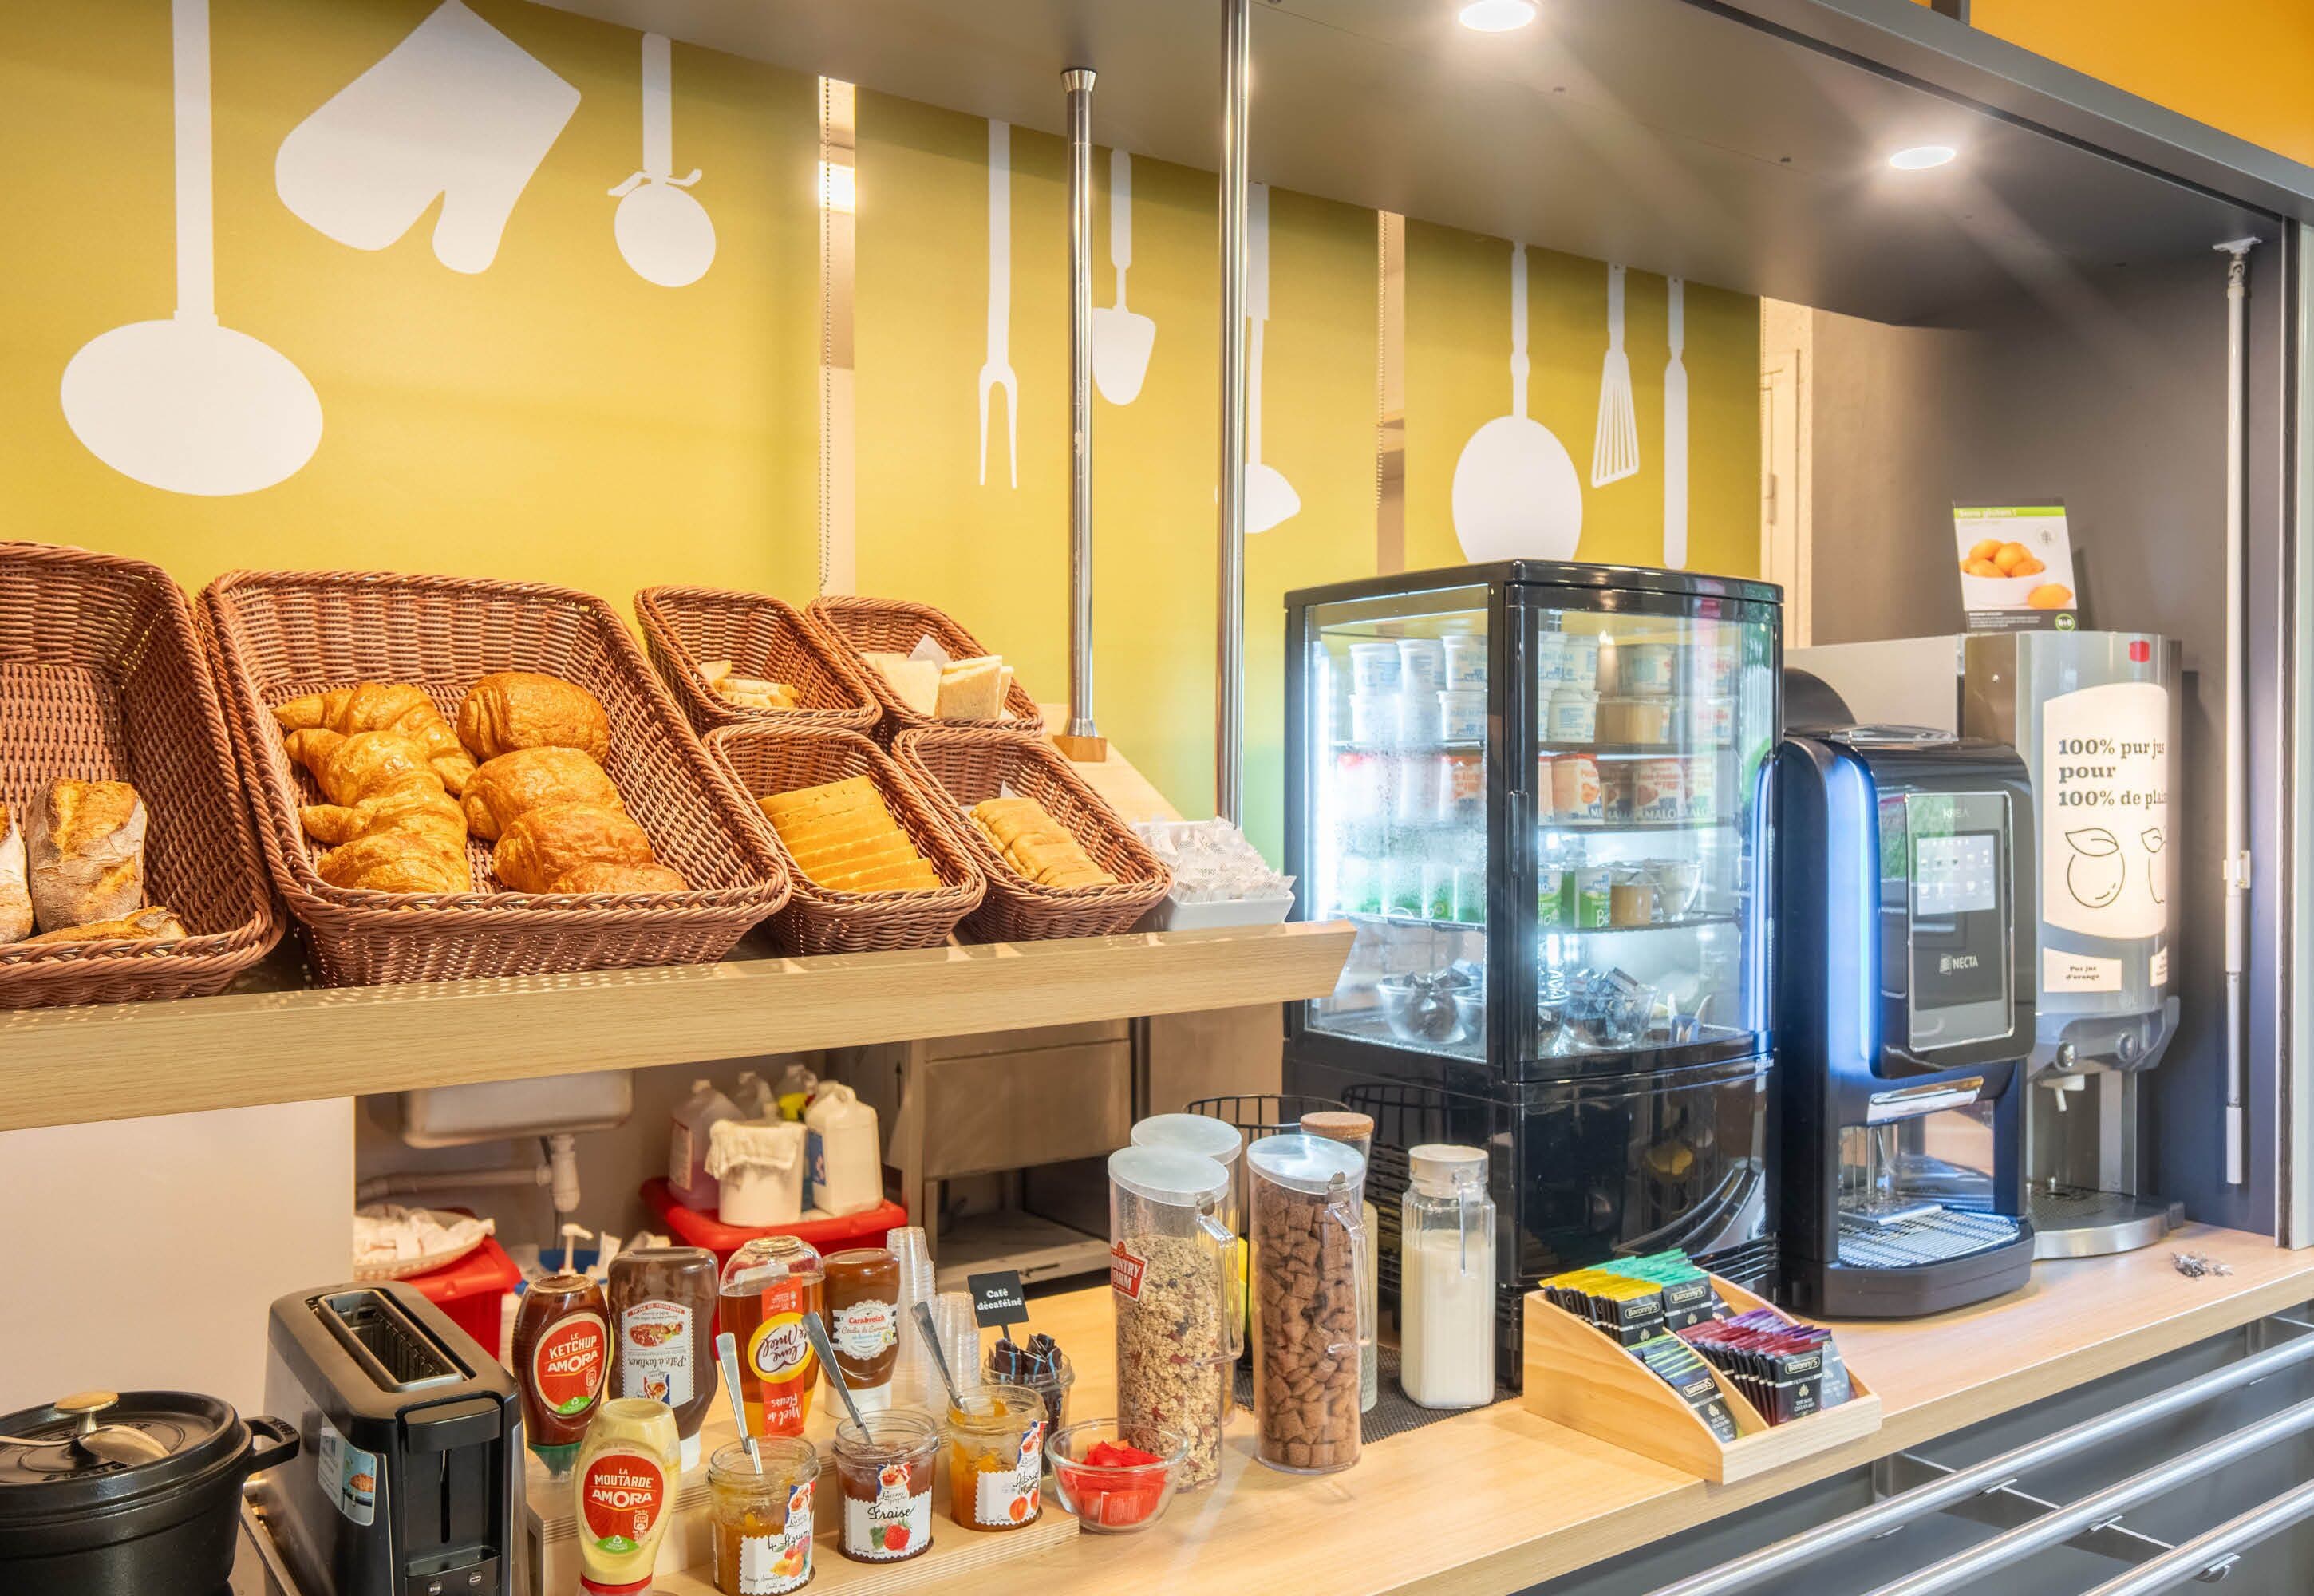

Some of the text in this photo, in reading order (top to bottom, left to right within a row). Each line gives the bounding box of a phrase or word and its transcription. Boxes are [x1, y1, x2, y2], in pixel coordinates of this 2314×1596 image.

[2059, 738, 2165, 759] 100% pur jus
[2059, 766, 2116, 784] pour
[2059, 790, 2115, 806] 100%
[2120, 790, 2141, 805] de
[1953, 955, 1979, 970] NECTA
[986, 1287, 1009, 1299] Café
[977, 1298, 1023, 1311] décaféiné
[848, 1315, 885, 1325] Carabreizh
[549, 1335, 597, 1359] KETCHUP
[547, 1350, 598, 1372] AMORA
[771, 1393, 798, 1408] Fleurs
[768, 1404, 801, 1426] Miel de
[594, 1475, 654, 1488] MOUTARDE
[592, 1489, 652, 1507] AMORA
[867, 1502, 916, 1519] Fraise
[768, 1536, 777, 1552] 4
